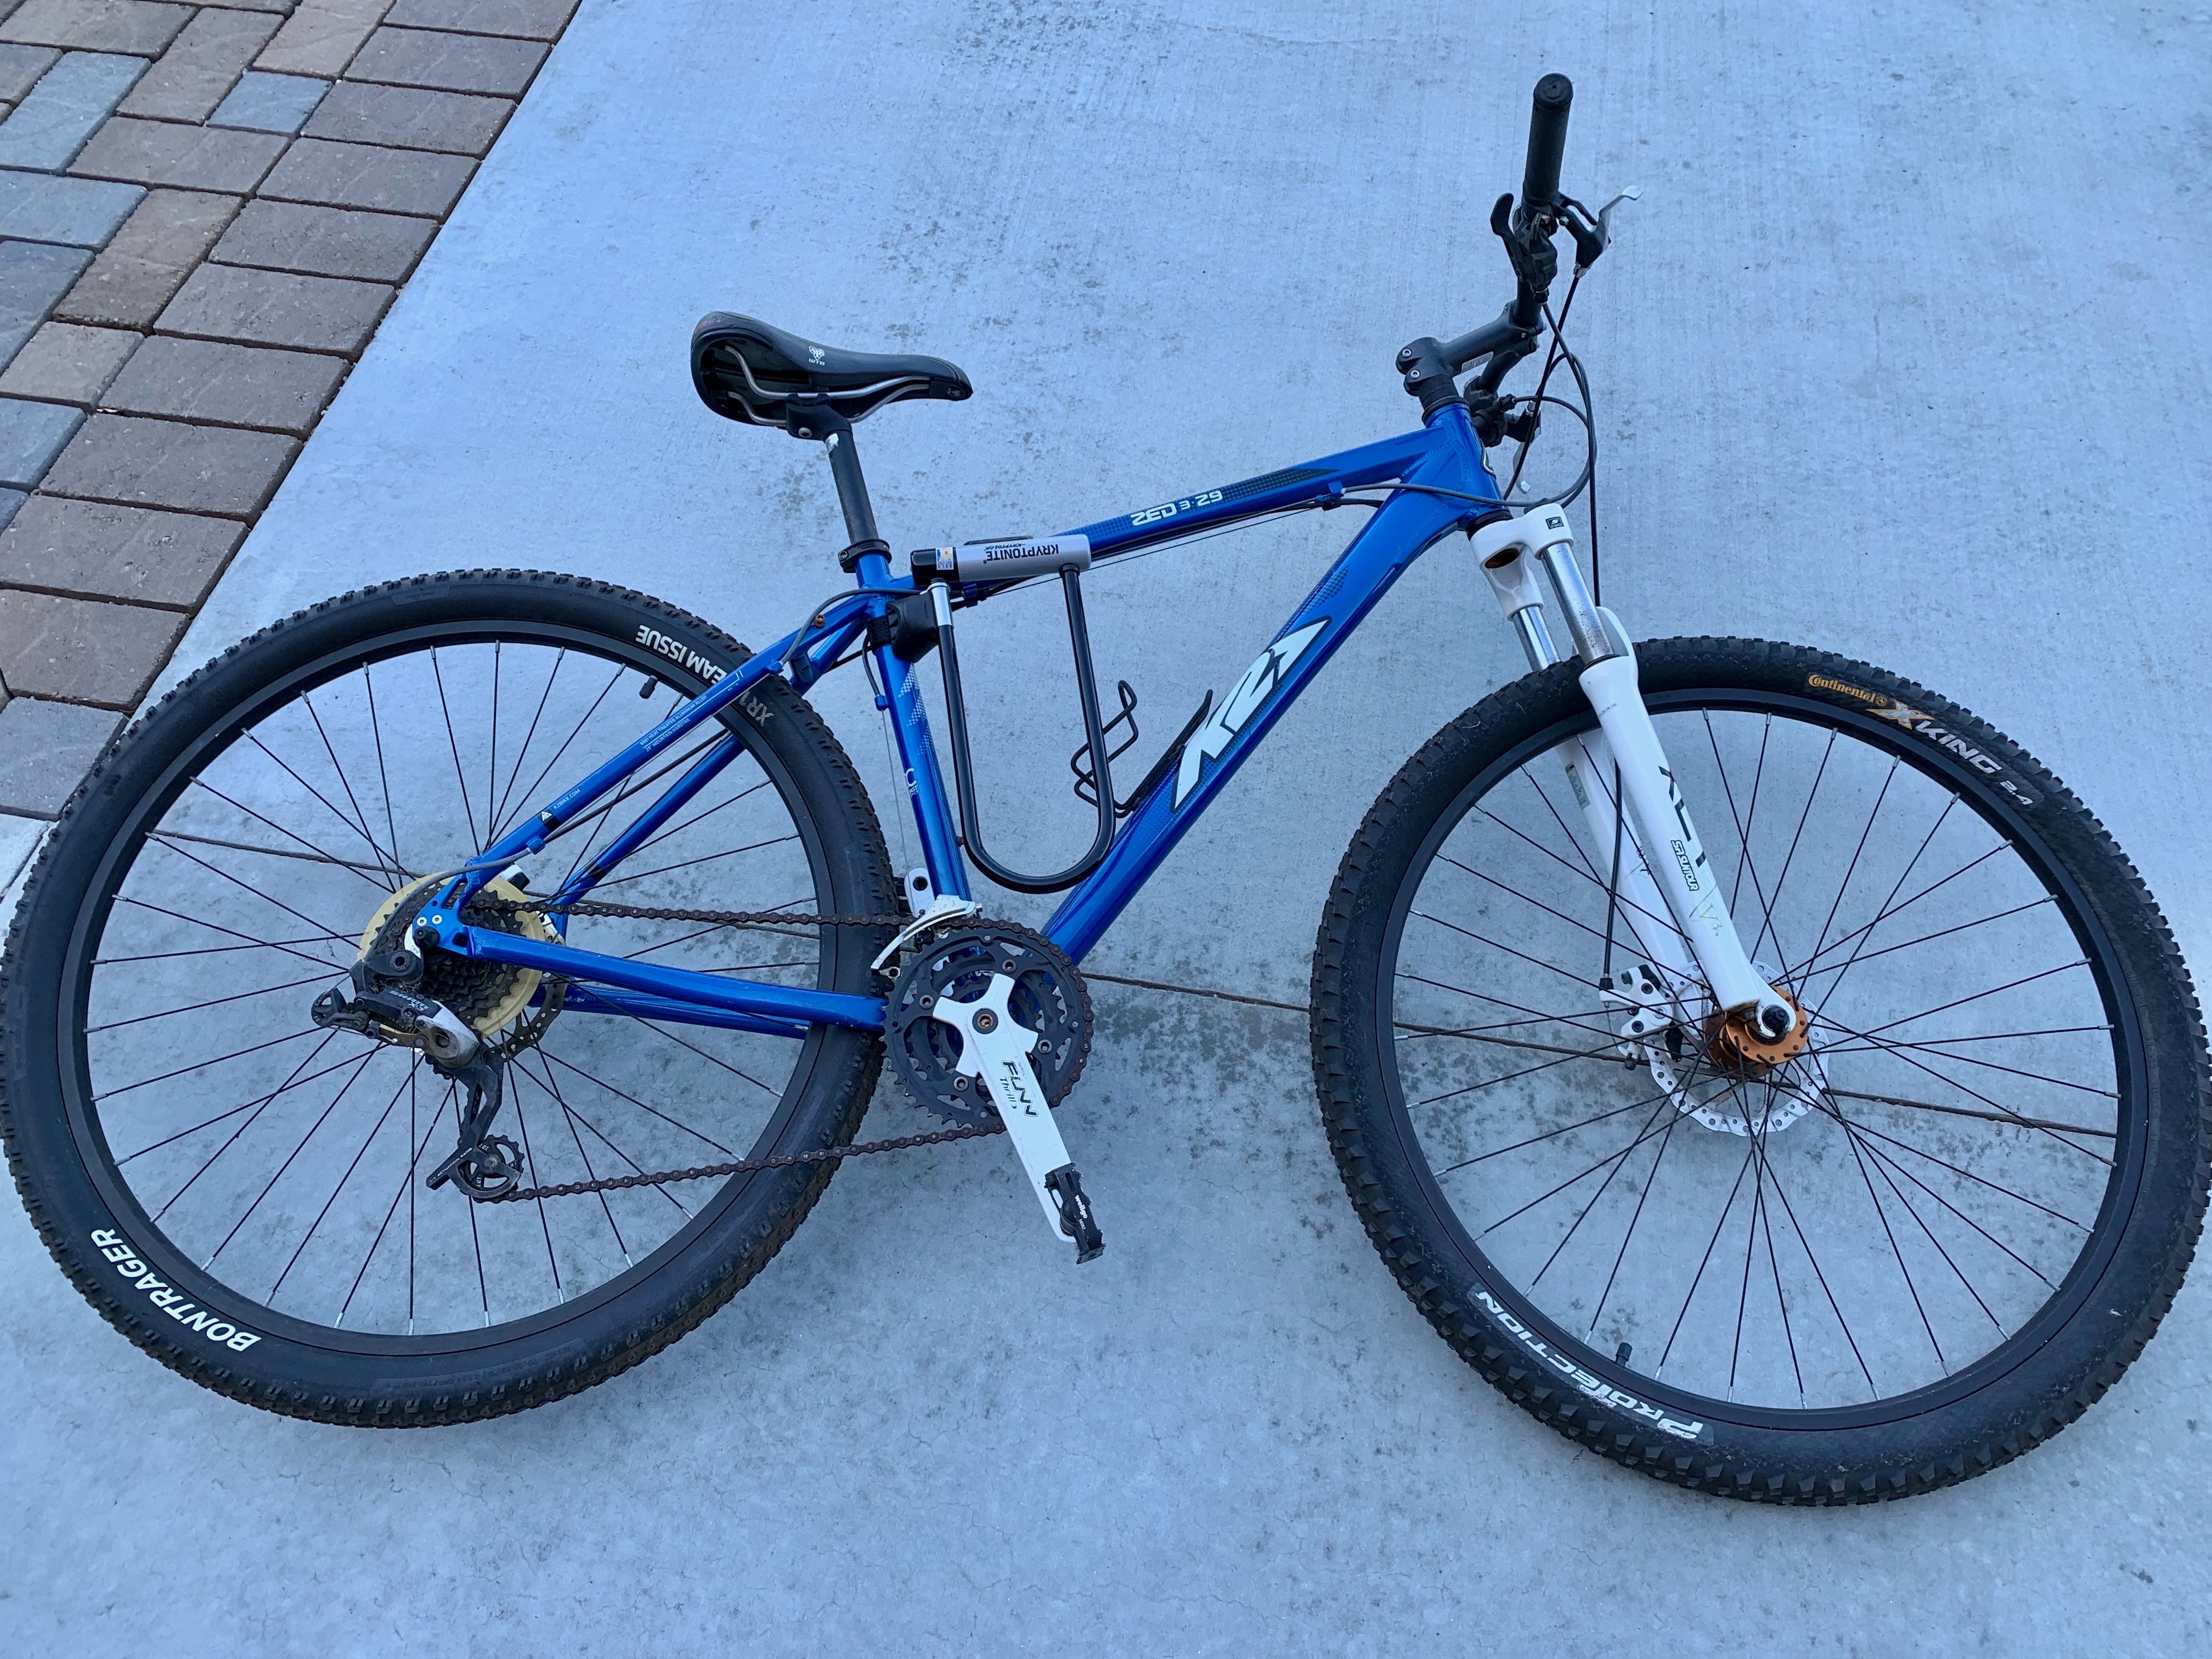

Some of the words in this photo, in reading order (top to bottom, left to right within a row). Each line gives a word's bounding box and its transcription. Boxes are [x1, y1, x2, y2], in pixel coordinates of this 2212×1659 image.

[809, 358, 825, 366] WTB
[1130, 503, 1178, 527] ZED
[985, 543, 1059, 562] KRYPTONITE
[635, 624, 688, 664] ISSUE
[686, 650, 728, 685] EAM
[1808, 674, 1875, 704] Continental
[648, 730, 659, 739] HEAT
[658, 718, 676, 732] TREATED
[675, 703, 696, 720] ALUMINUM
[695, 695, 707, 706] ALLOY
[652, 730, 673, 747] MOUNTAIN
[1915, 720, 2002, 774] KING
[2000, 780, 2034, 805] 2.4
[1676, 855, 1700, 891] SUNTOUR
[1075, 1194, 1088, 1219] wellgo
[91, 1228, 262, 1352] BONTRAGER
[1475, 1290, 1704, 1440] PROTECTION
